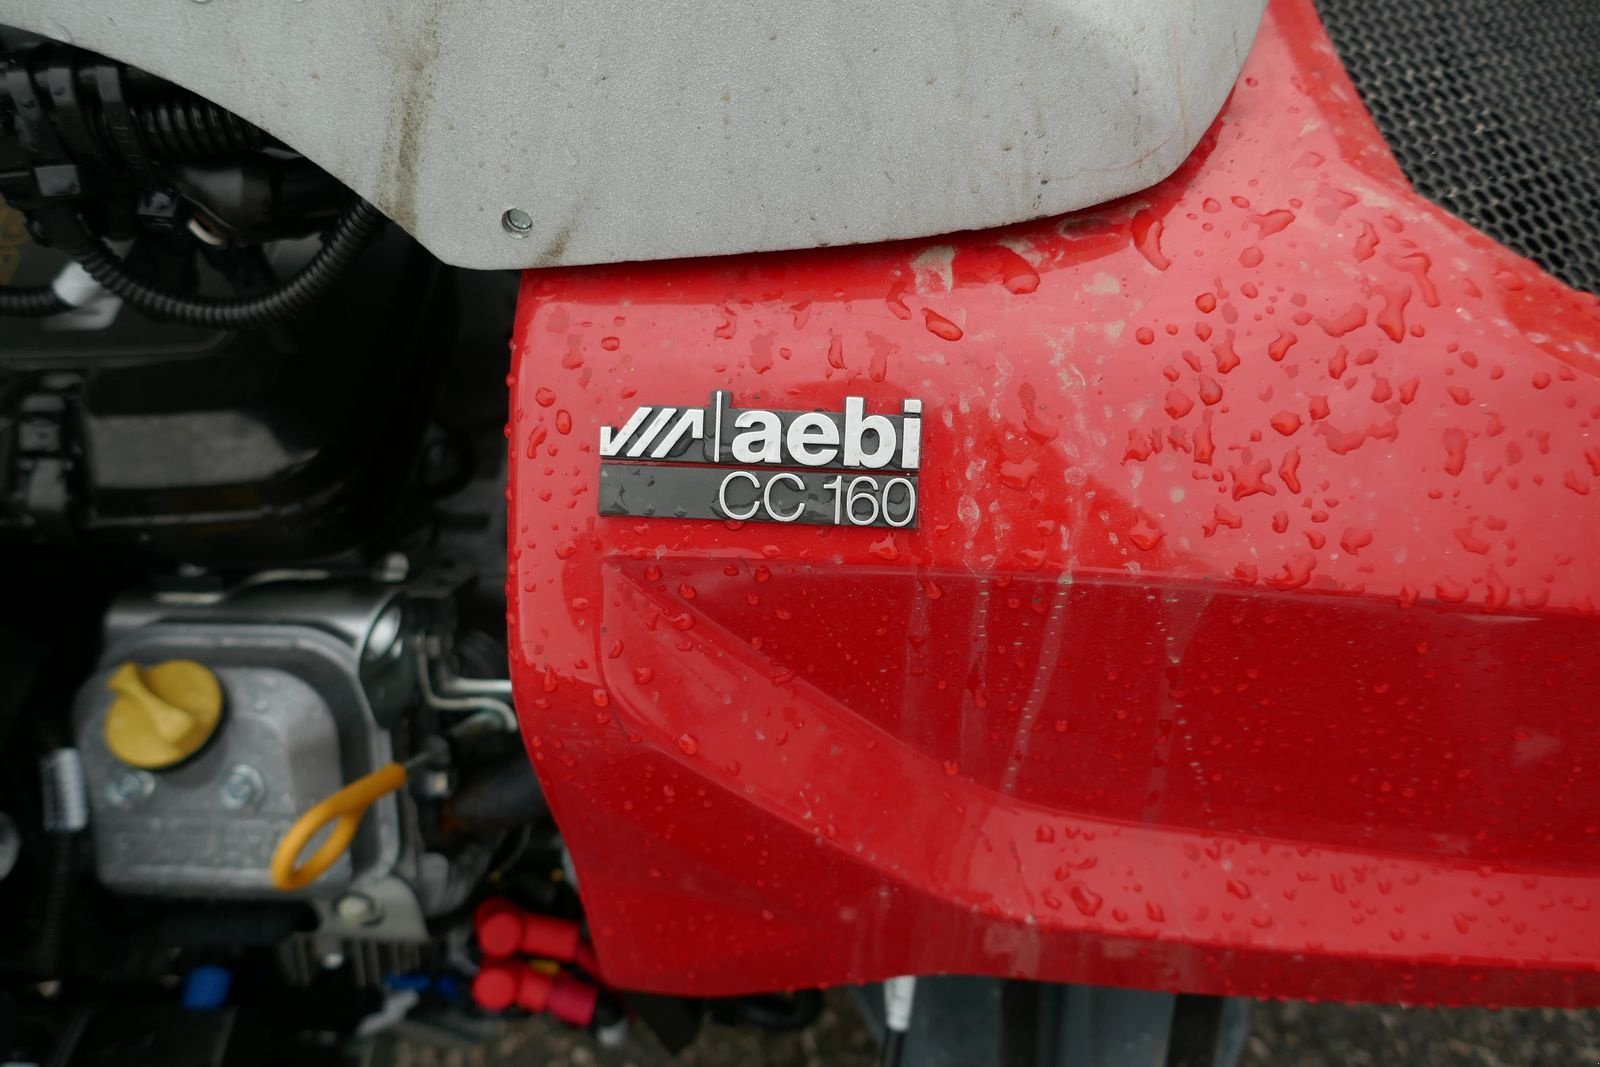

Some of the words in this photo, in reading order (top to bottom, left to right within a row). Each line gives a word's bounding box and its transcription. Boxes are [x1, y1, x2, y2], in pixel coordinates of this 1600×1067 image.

[731, 396, 922, 469] aebi
[719, 470, 806, 522] CC
[822, 475, 916, 527] 160
